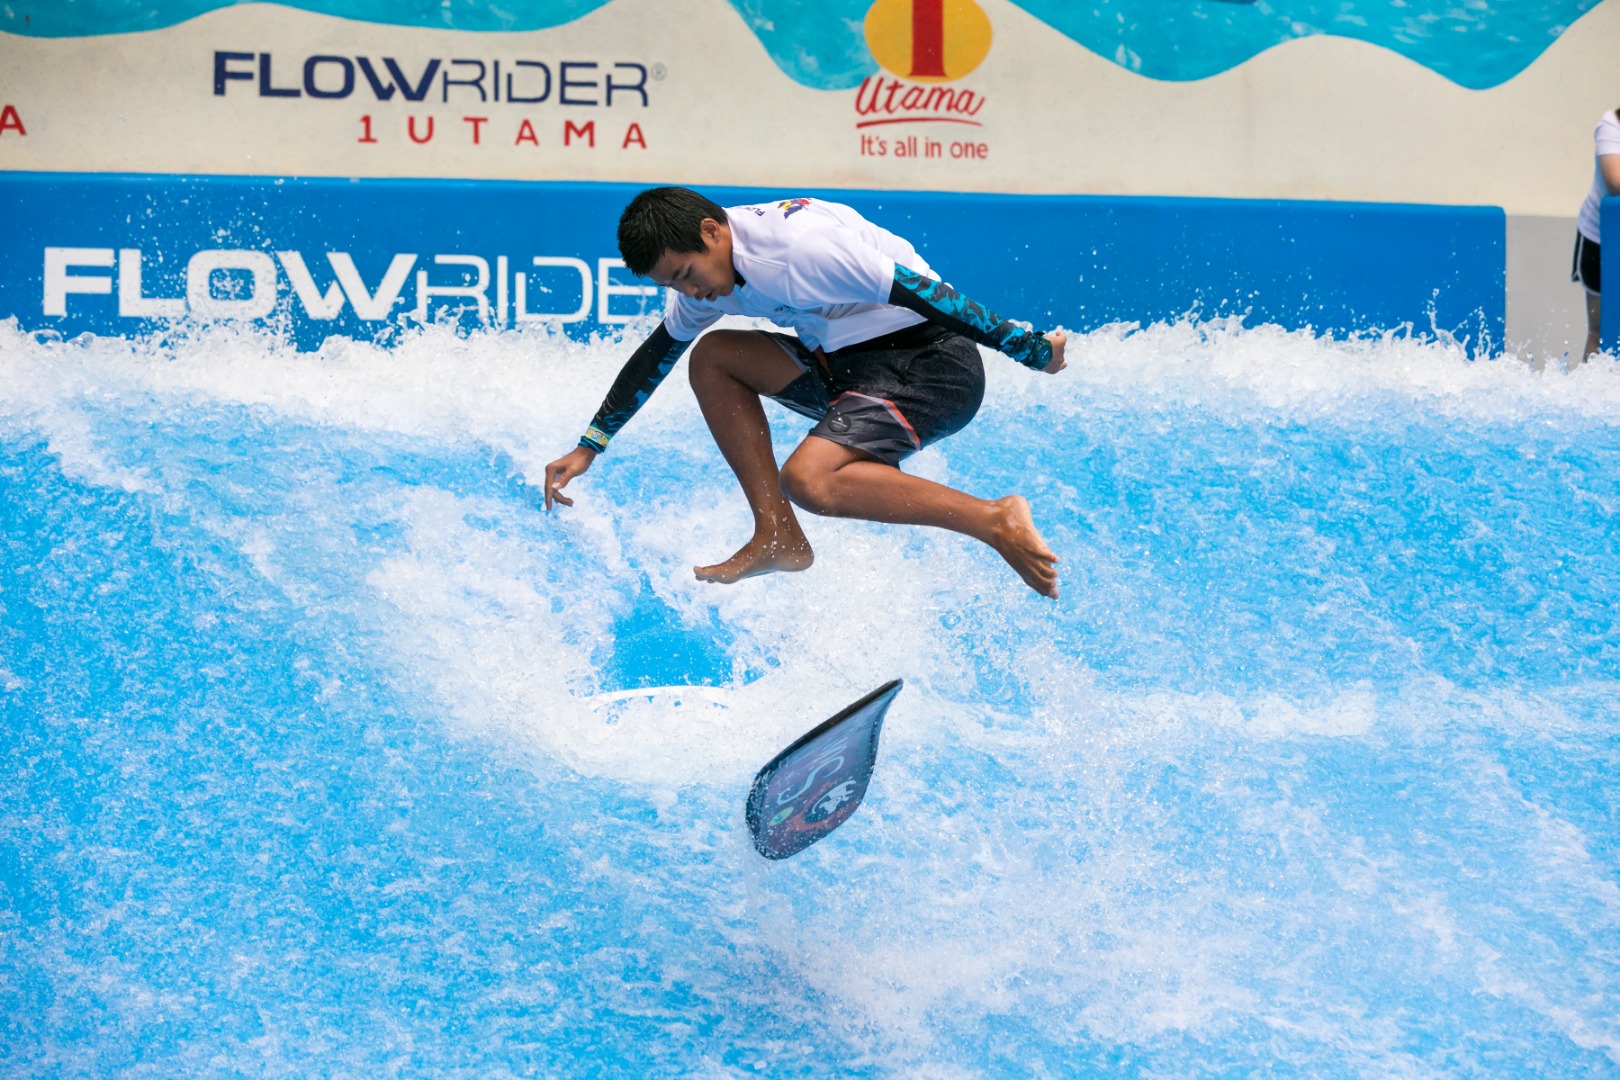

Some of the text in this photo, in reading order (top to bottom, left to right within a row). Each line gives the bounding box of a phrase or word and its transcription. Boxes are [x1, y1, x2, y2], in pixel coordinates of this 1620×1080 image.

[855, 76, 985, 115] Utama
[861, 134, 989, 159] It's all in one
